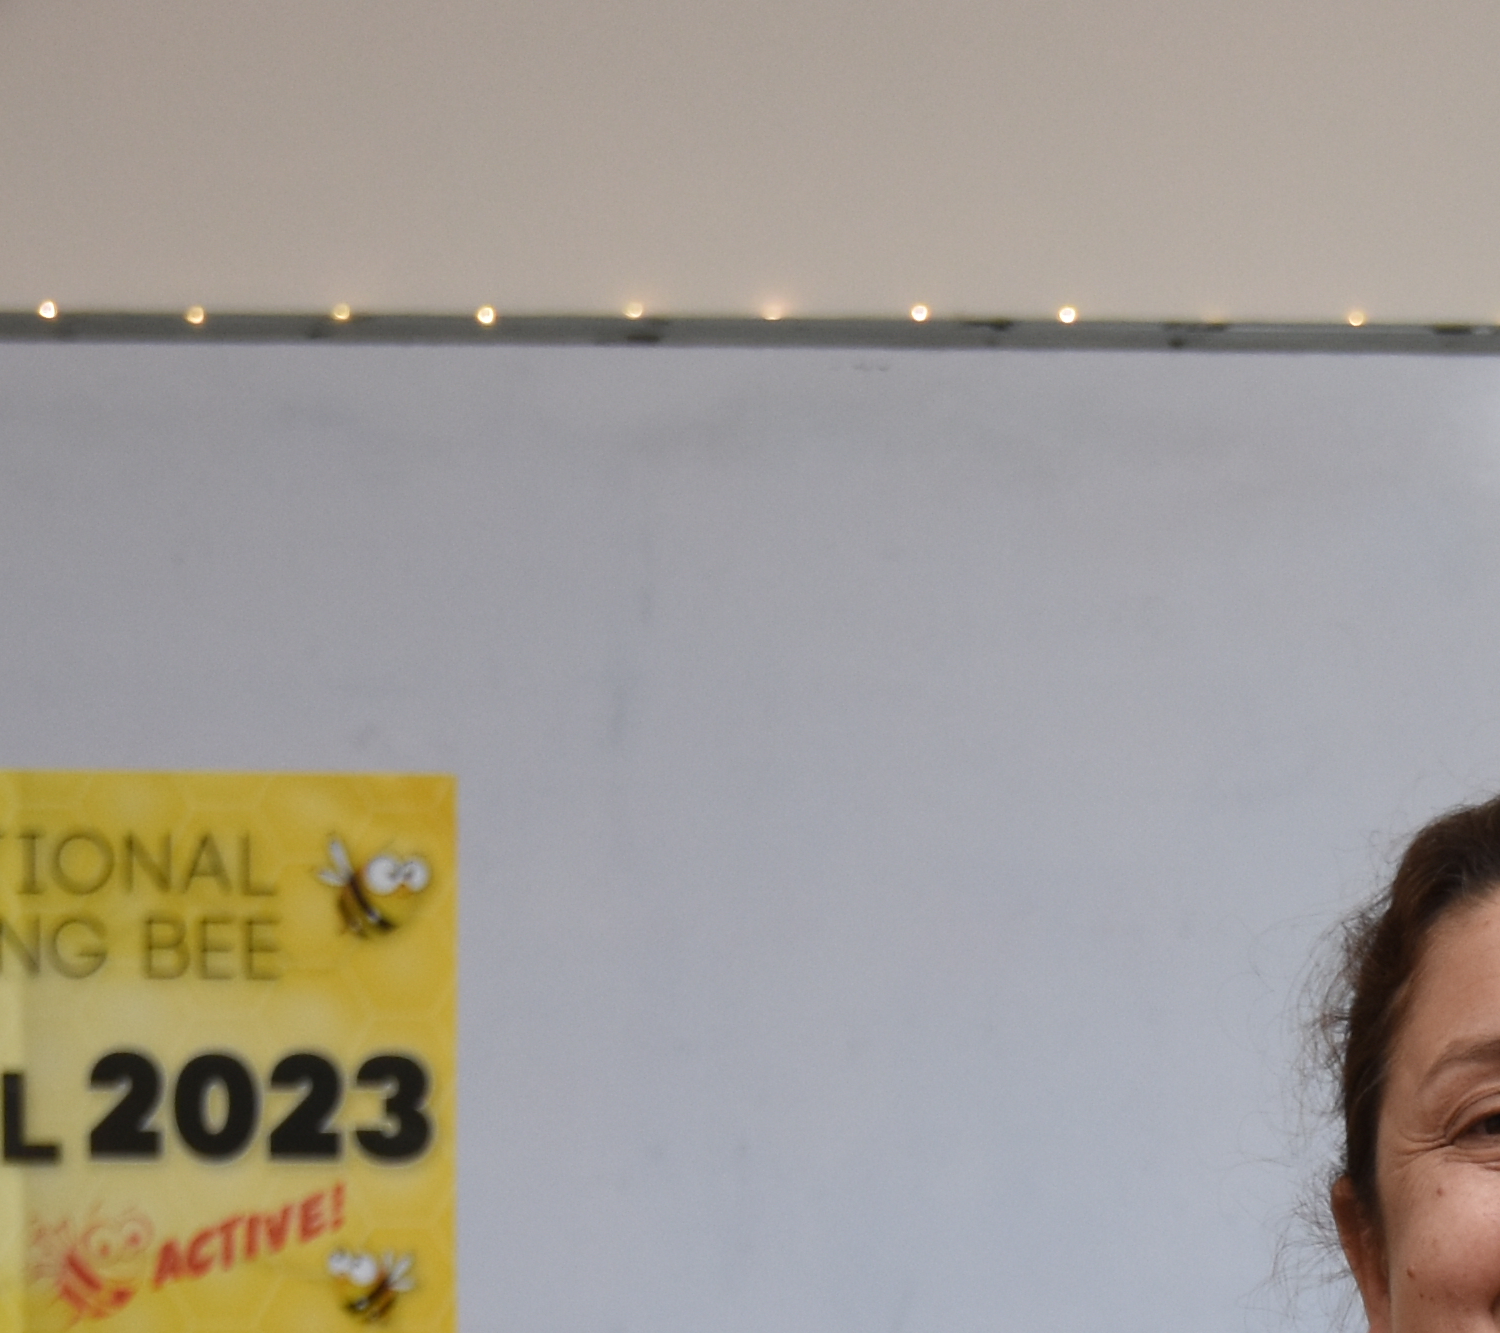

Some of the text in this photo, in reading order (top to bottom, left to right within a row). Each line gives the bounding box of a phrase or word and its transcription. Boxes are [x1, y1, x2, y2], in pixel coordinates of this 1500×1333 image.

[143, 915, 280, 981] BEE
[86, 1046, 436, 1164] 2023
[151, 1182, 347, 1291] ACTIVE!
